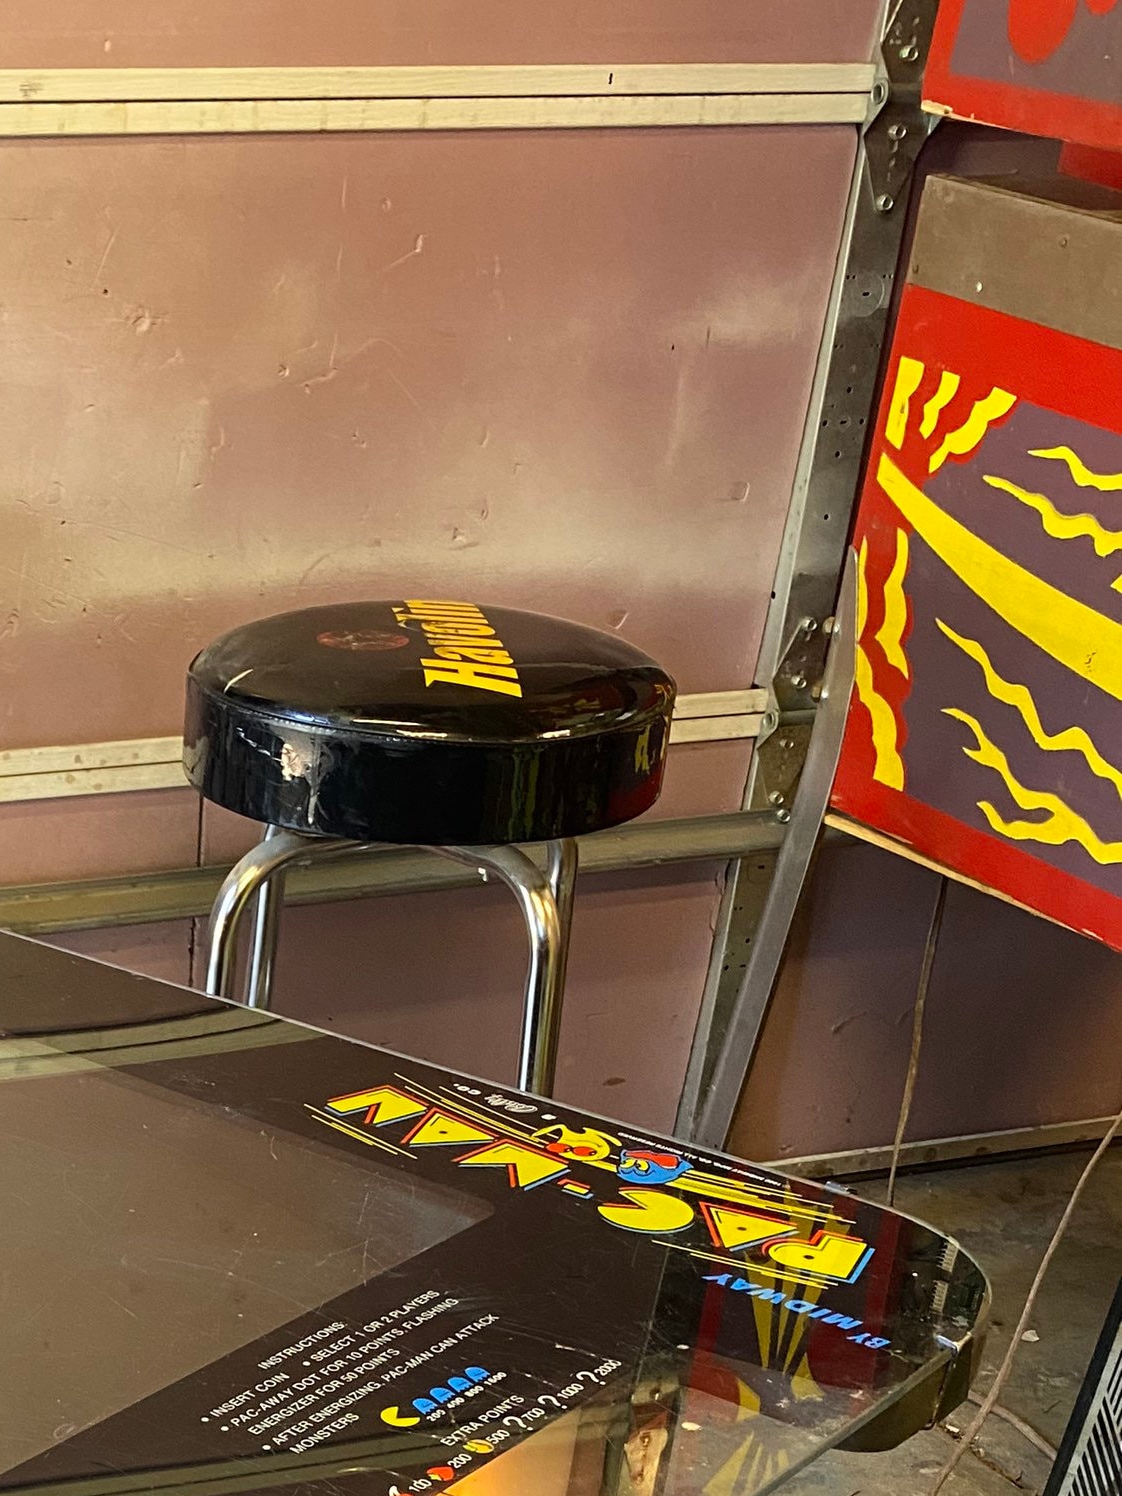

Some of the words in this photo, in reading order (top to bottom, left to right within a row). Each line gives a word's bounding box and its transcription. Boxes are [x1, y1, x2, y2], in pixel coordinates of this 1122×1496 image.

[324, 1085, 875, 1284] PAC-MAN
[310, 1335, 356, 1362] SELECT
[355, 1330, 366, 1338] 1
[363, 1320, 384, 1333] OR
[380, 1315, 393, 1324] 2
[389, 1290, 440, 1320] PLAYERS
[702, 1273, 862, 1331] MIDWAY
[230, 1388, 294, 1427] PAC-AWAY
[292, 1373, 322, 1391] DOT
[319, 1360, 348, 1376] FOR
[346, 1351, 363, 1361] 10
[401, 1297, 459, 1330] FLASHING
[846, 1332, 891, 1350] BY
[209, 1390, 256, 1417] INSERT
[255, 1372, 290, 1393] COIN
[247, 1394, 320, 1435] ENERGIZER
[315, 1380, 345, 1397] FOR
[342, 1371, 358, 1383] 50
[354, 1348, 400, 1376] POINTS
[272, 1421, 314, 1446] AFTER
[381, 1350, 434, 1382] PAC-MAN
[430, 1337, 458, 1354] CAN
[454, 1313, 500, 1341] ATTACK
[446, 1396, 465, 1410] 400
[464, 1385, 484, 1398] 800
[483, 1372, 507, 1386] 1600
[289, 1413, 360, 1454] MONSTERS
[408, 1477, 432, 1493] 100
[447, 1453, 473, 1469] 200
[485, 1429, 510, 1445] 500
[521, 1407, 546, 1423] 700
[556, 1383, 584, 1399] 1000
[594, 1359, 622, 1377] 2000
[440, 1422, 483, 1447] EXTRA
[478, 1394, 525, 1423] POINTS
